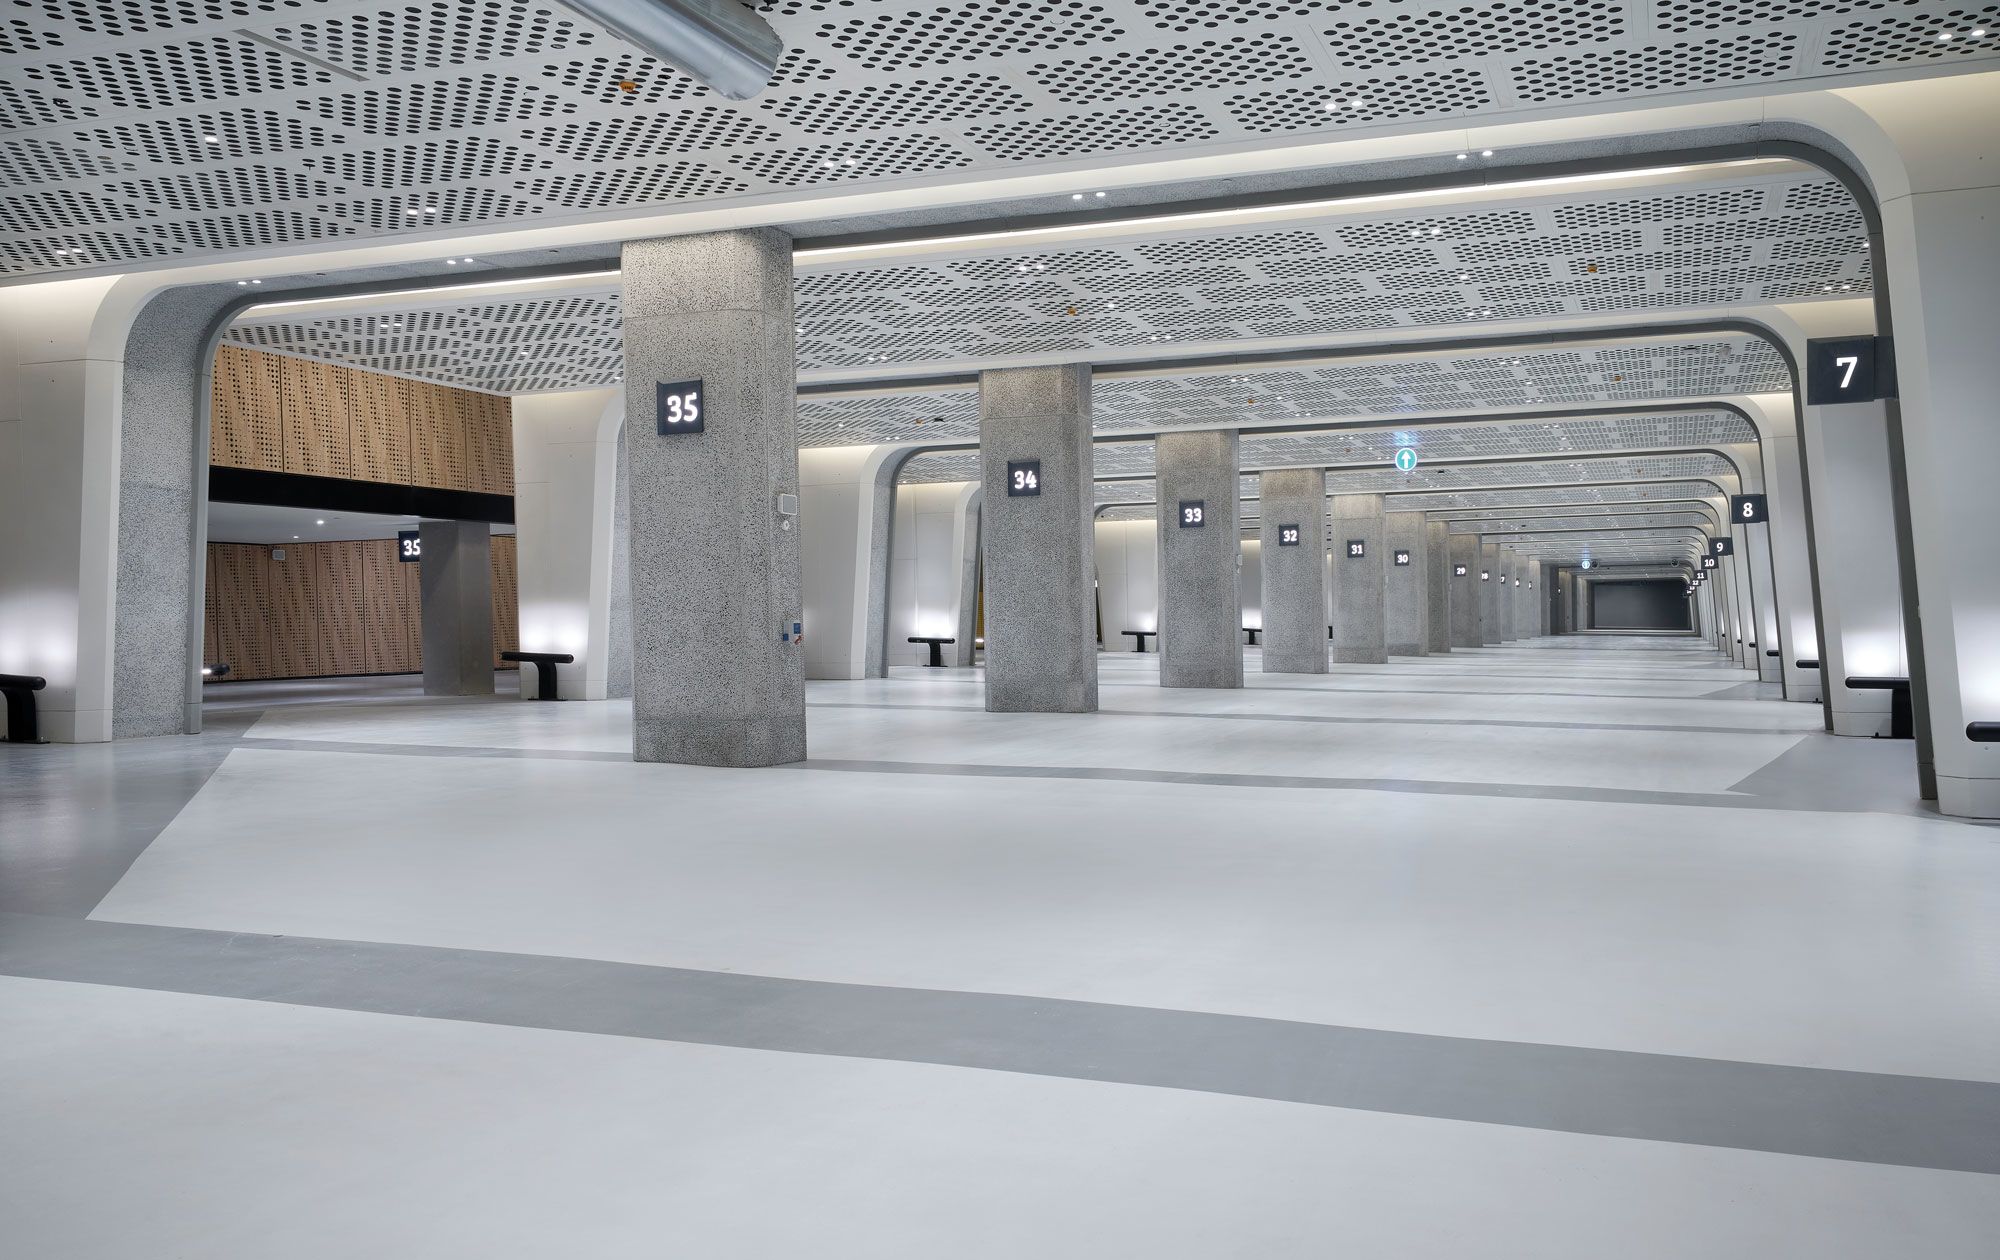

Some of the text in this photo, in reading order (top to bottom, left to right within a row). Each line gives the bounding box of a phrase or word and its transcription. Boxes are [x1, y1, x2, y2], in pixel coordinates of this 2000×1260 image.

[1836, 356, 1858, 389] 7
[667, 391, 699, 424] 35
[1014, 470, 1037, 490] 34
[1184, 507, 1202, 523] 33
[1742, 502, 1754, 518] 8
[1283, 529, 1298, 543] 32
[1351, 544, 1363, 555] 31
[1716, 542, 1724, 553] 9
[1397, 553, 1409, 564] 30
[1704, 558, 1715, 567] 10
[1456, 567, 1466, 575] 29
